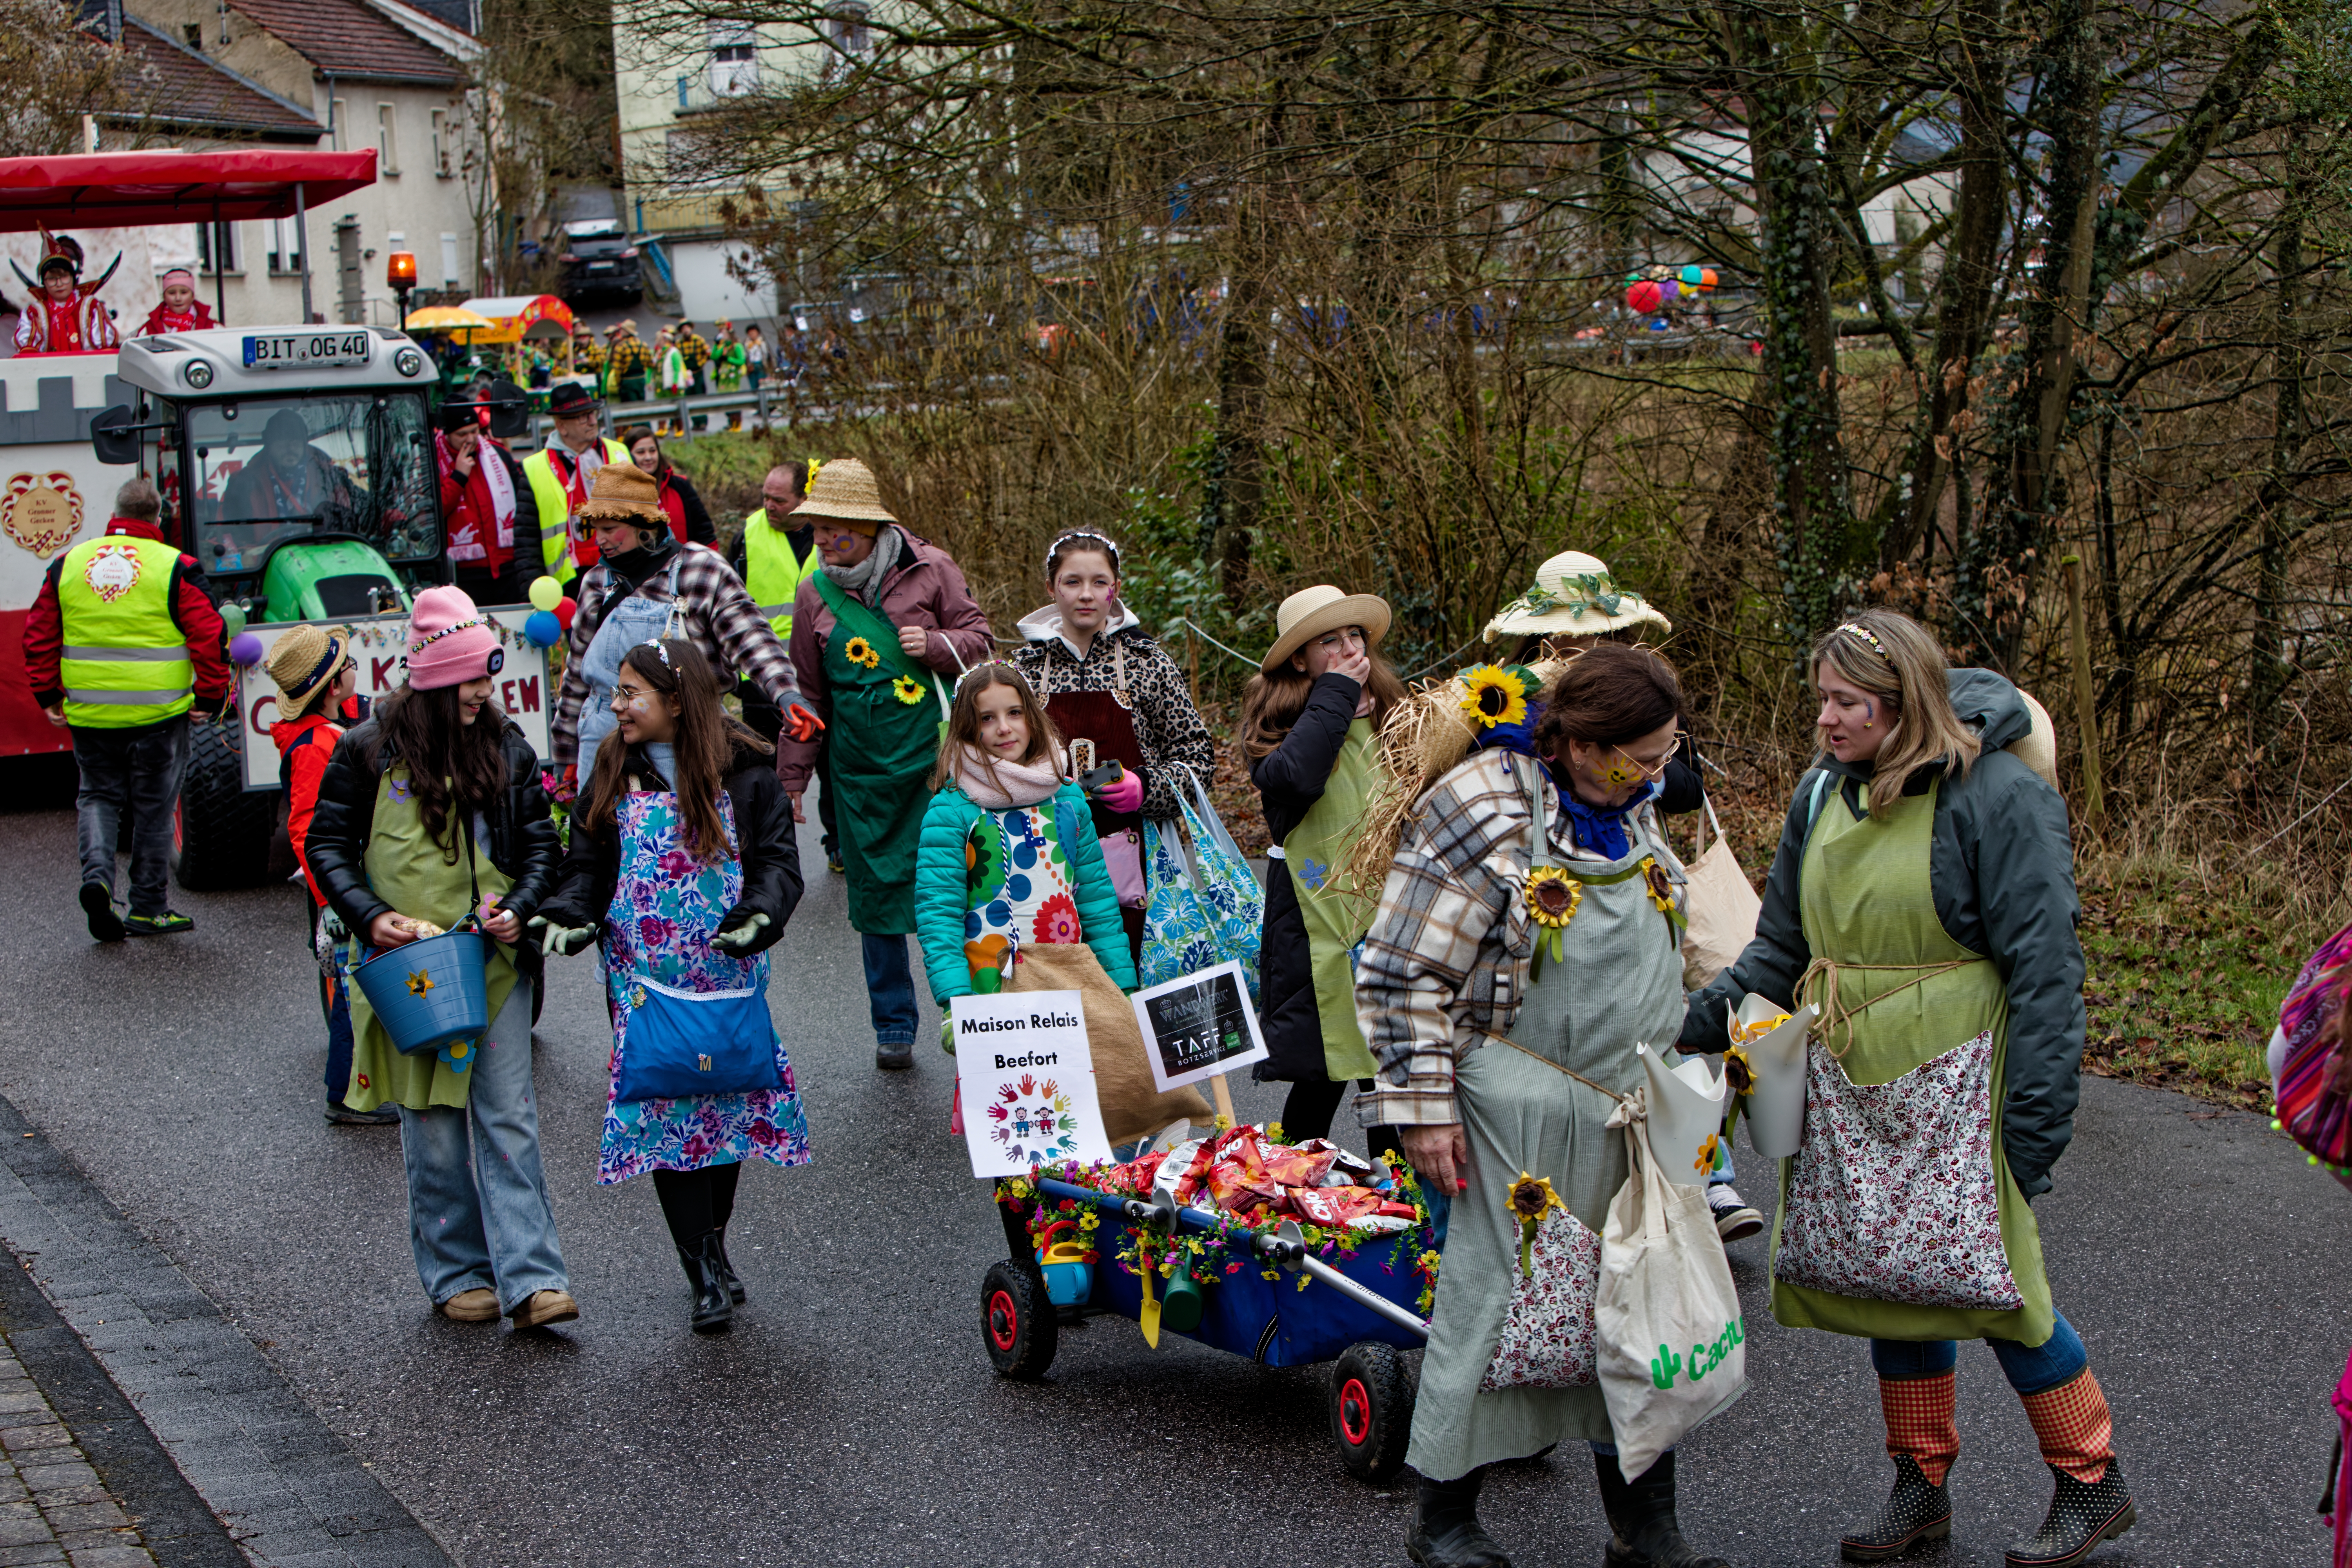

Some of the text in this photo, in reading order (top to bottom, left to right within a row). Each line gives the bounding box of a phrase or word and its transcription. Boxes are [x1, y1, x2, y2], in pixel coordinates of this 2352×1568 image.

[256, 336, 365, 359] BIT OG 40
[962, 1012, 1078, 1034] Maison Relais
[1172, 1027, 1220, 1056] TAFF
[700, 1056, 711, 1071] M
[995, 1051, 1058, 1069] Beefort
[1178, 1045, 1225, 1066] BOTZSERVICE
[1211, 1138, 1243, 1167] hio
[1305, 1191, 1332, 1220] Chio
[1689, 1316, 1744, 1381] Cactu
